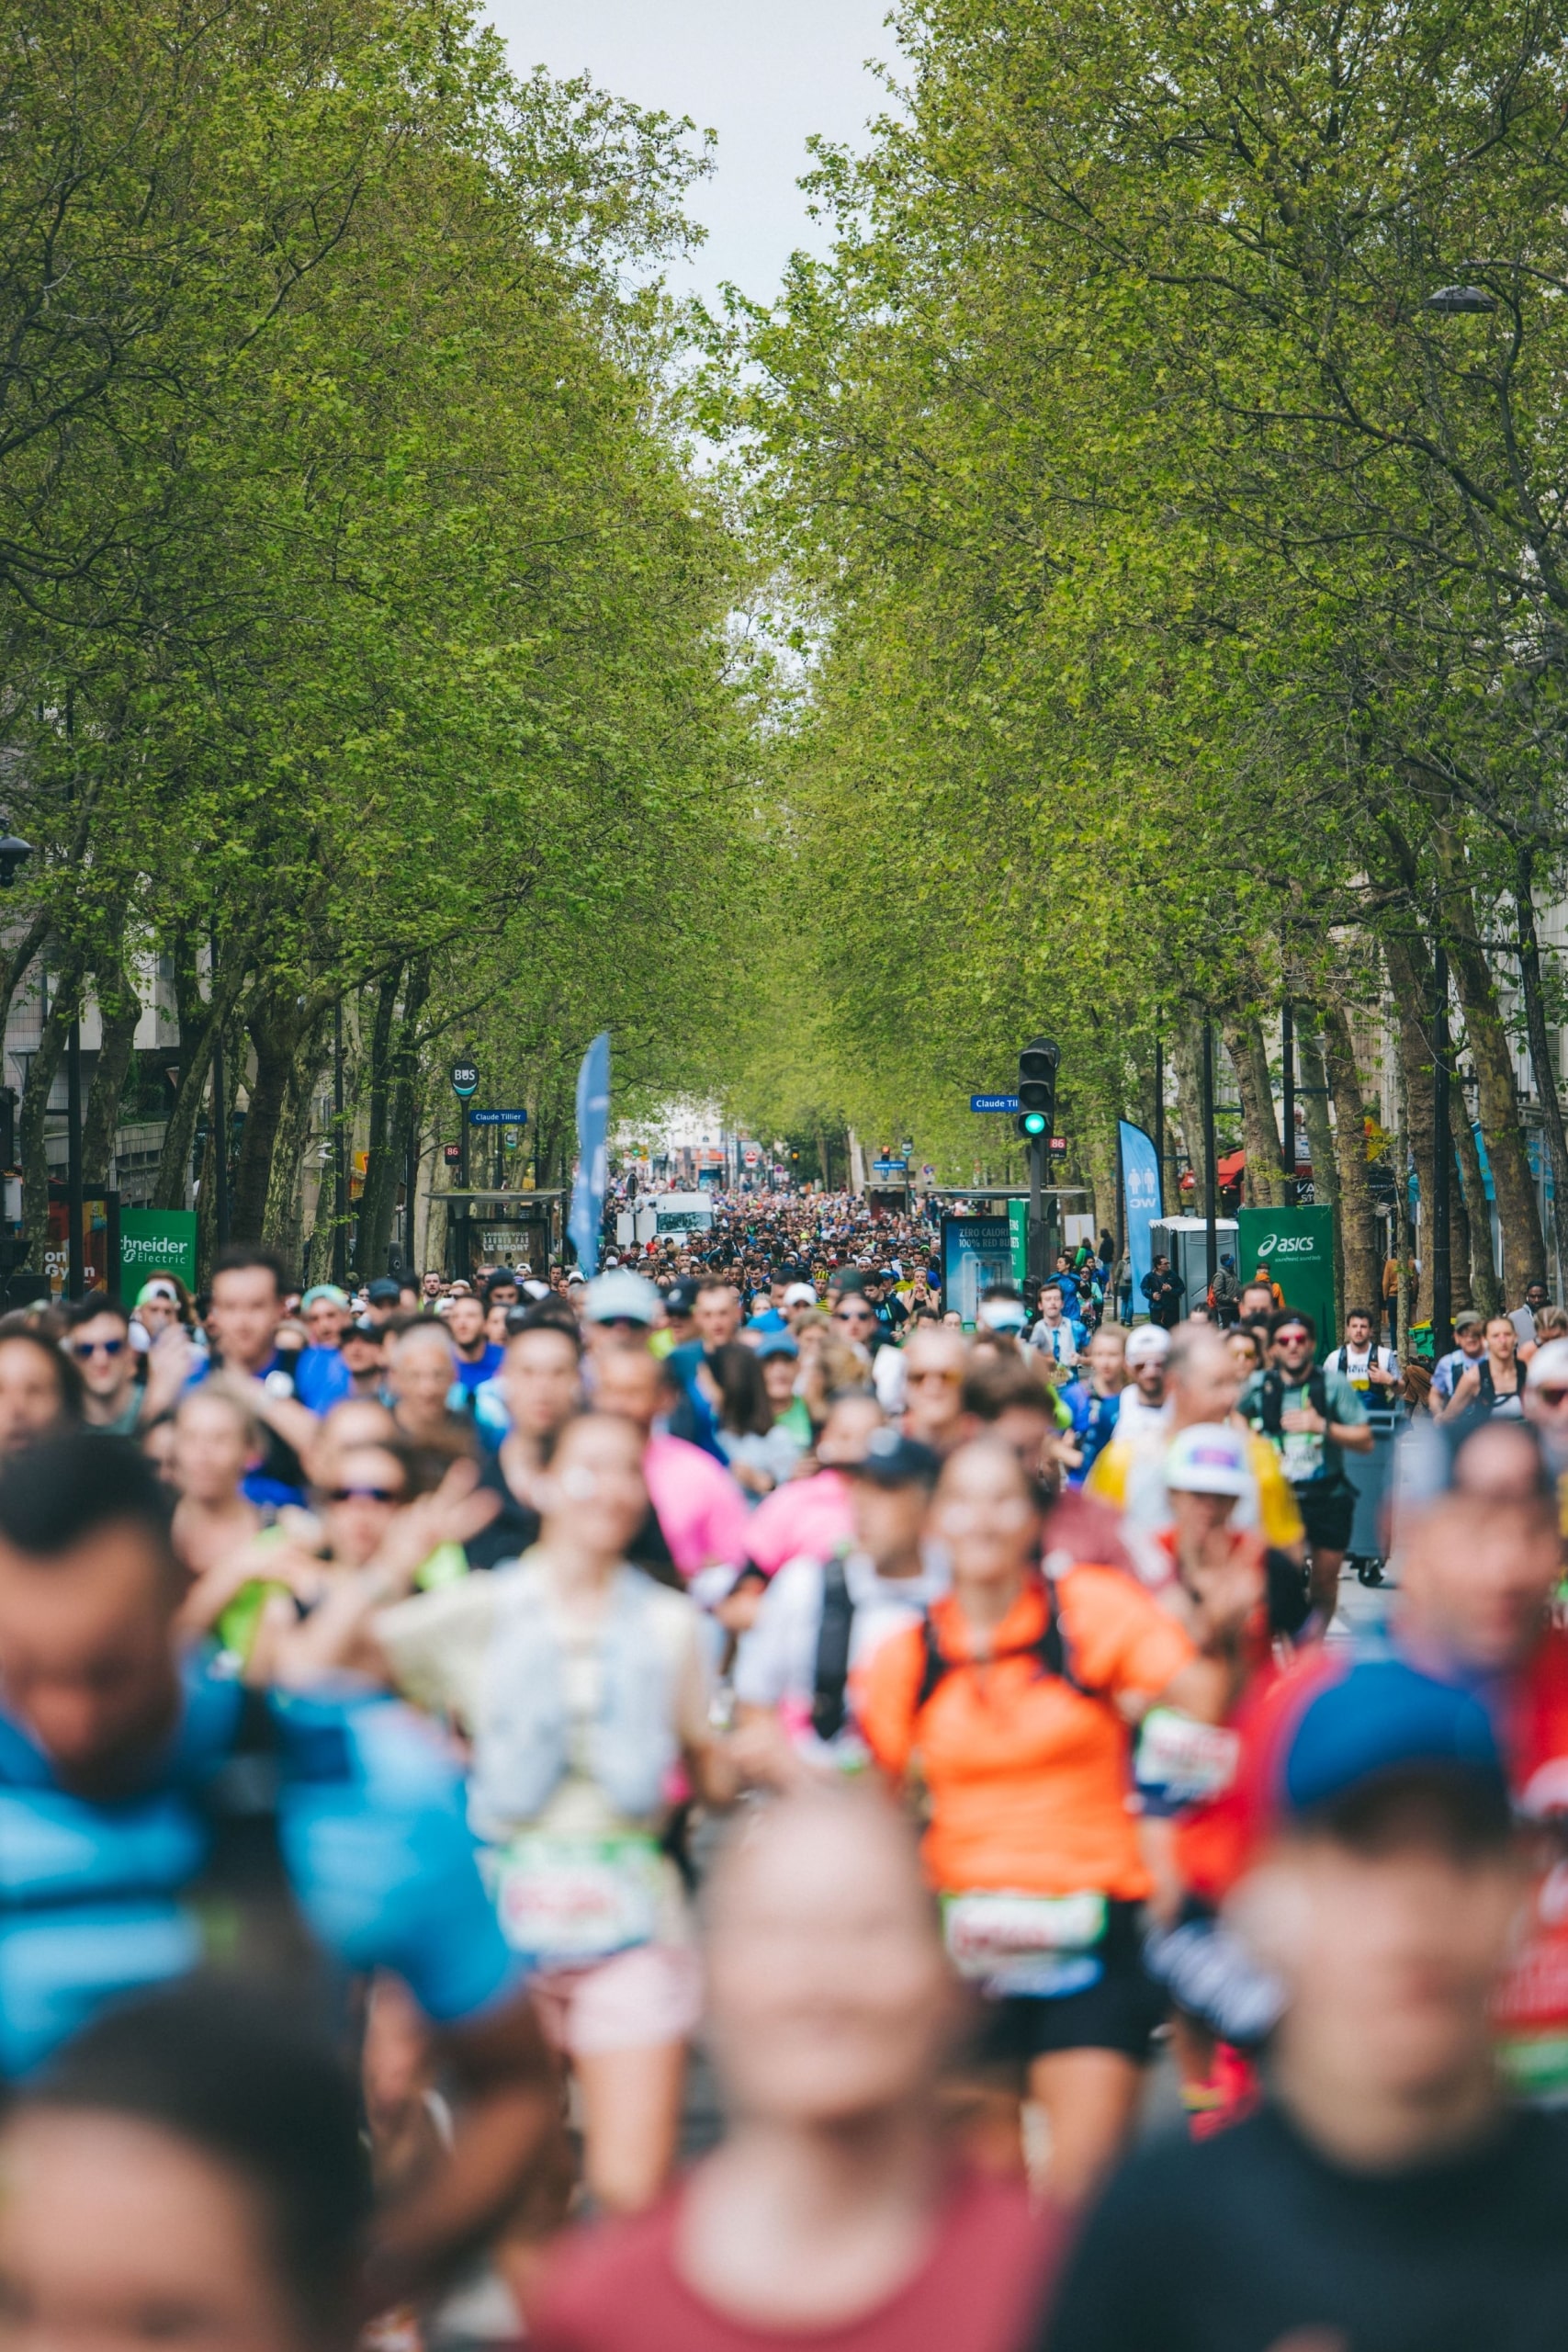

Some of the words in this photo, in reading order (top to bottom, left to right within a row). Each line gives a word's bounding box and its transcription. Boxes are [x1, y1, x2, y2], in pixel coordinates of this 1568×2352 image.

[454, 1069, 476, 1080] BUS
[976, 1100, 1005, 1108] Claude
[1007, 1099, 1019, 1107] Til
[501, 1113, 522, 1121] Tillier
[1051, 1139, 1065, 1148] 86
[446, 1148, 458, 1156] 86
[1296, 1182, 1315, 1194] VA
[959, 1227, 979, 1238] ZÉRO
[981, 1228, 1010, 1238] CALORI
[958, 1238, 980, 1248] 100%
[983, 1238, 998, 1248] RED
[999, 1238, 1010, 1248] BU
[138, 1252, 186, 1264] Electric
[45, 1263, 96, 1280] Gyn
